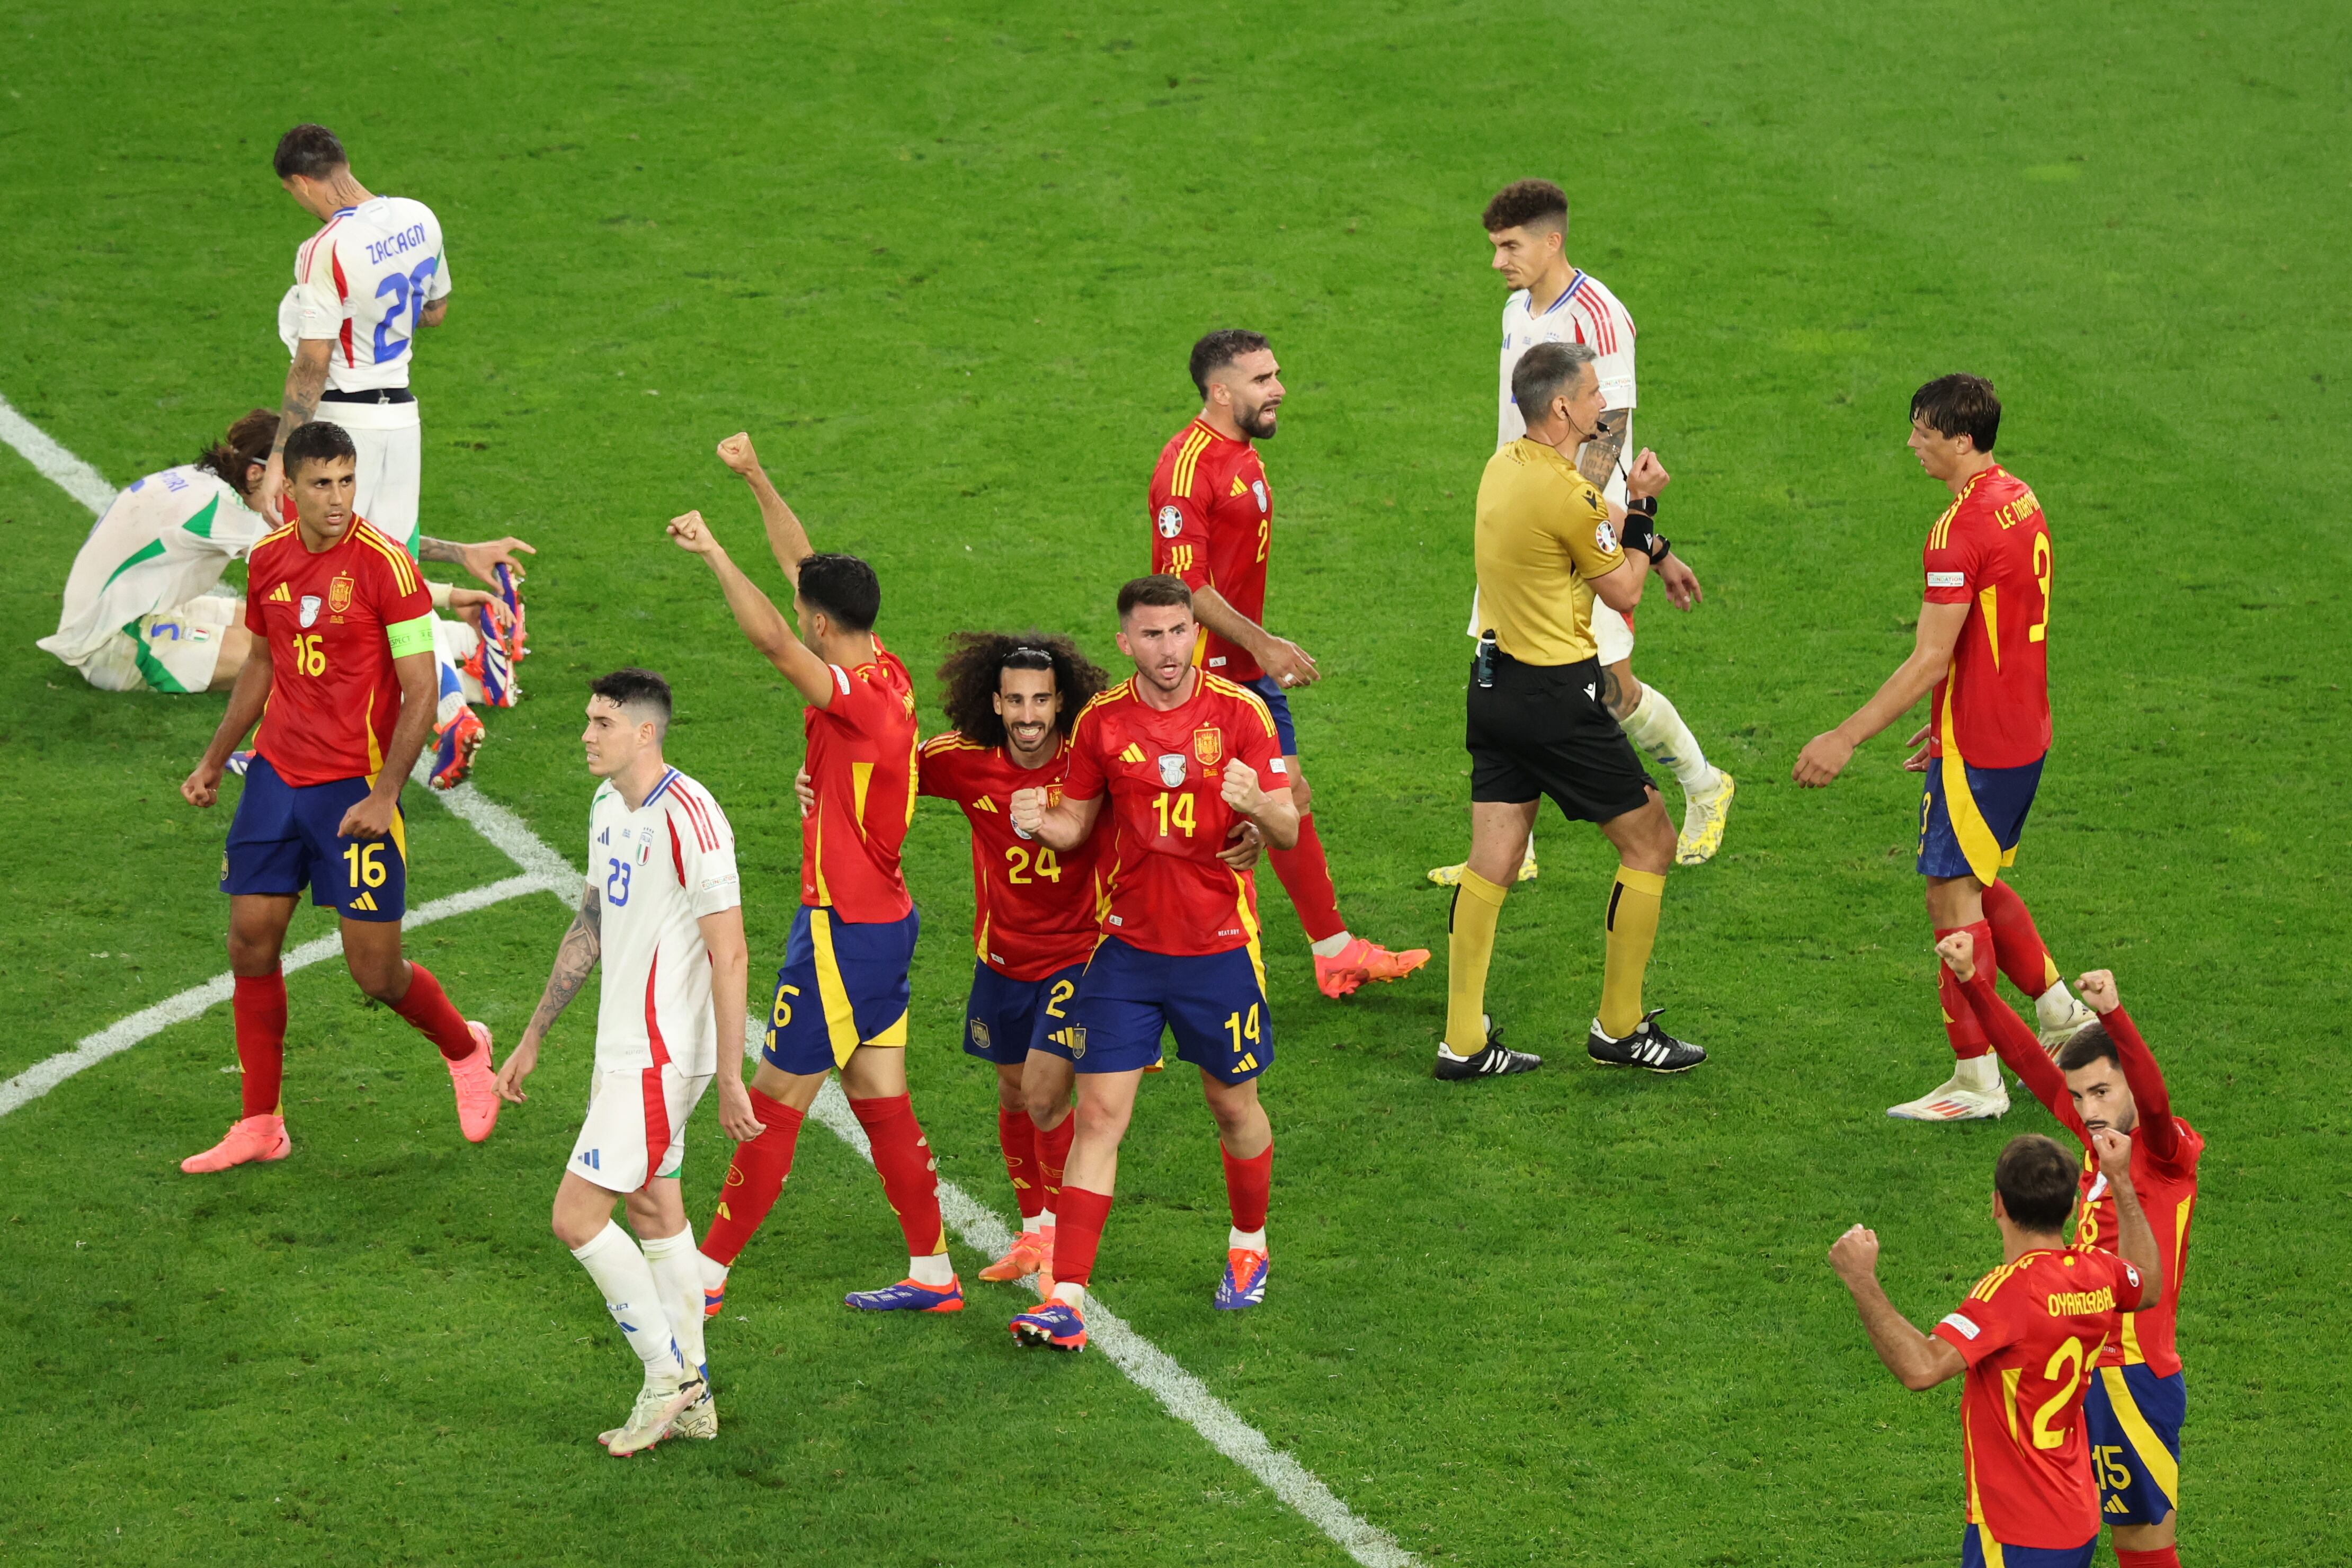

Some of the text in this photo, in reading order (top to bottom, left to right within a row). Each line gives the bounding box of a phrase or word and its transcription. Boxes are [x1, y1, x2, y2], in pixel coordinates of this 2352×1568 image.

[1256, 519, 1268, 563] 2
[1994, 510, 2016, 530] LE
[293, 633, 326, 676] 16
[389, 636, 411, 646] ESPECT
[1153, 792, 1196, 837] 14
[1921, 791, 1931, 835] 3
[343, 843, 386, 887] 16
[608, 858, 631, 907] 23
[1005, 846, 1061, 884] 24
[773, 985, 800, 1027] 6
[1224, 1002, 1260, 1053] 14
[2048, 1285, 2116, 1317] OYARZABAL
[2091, 1445, 2132, 1490] 15
